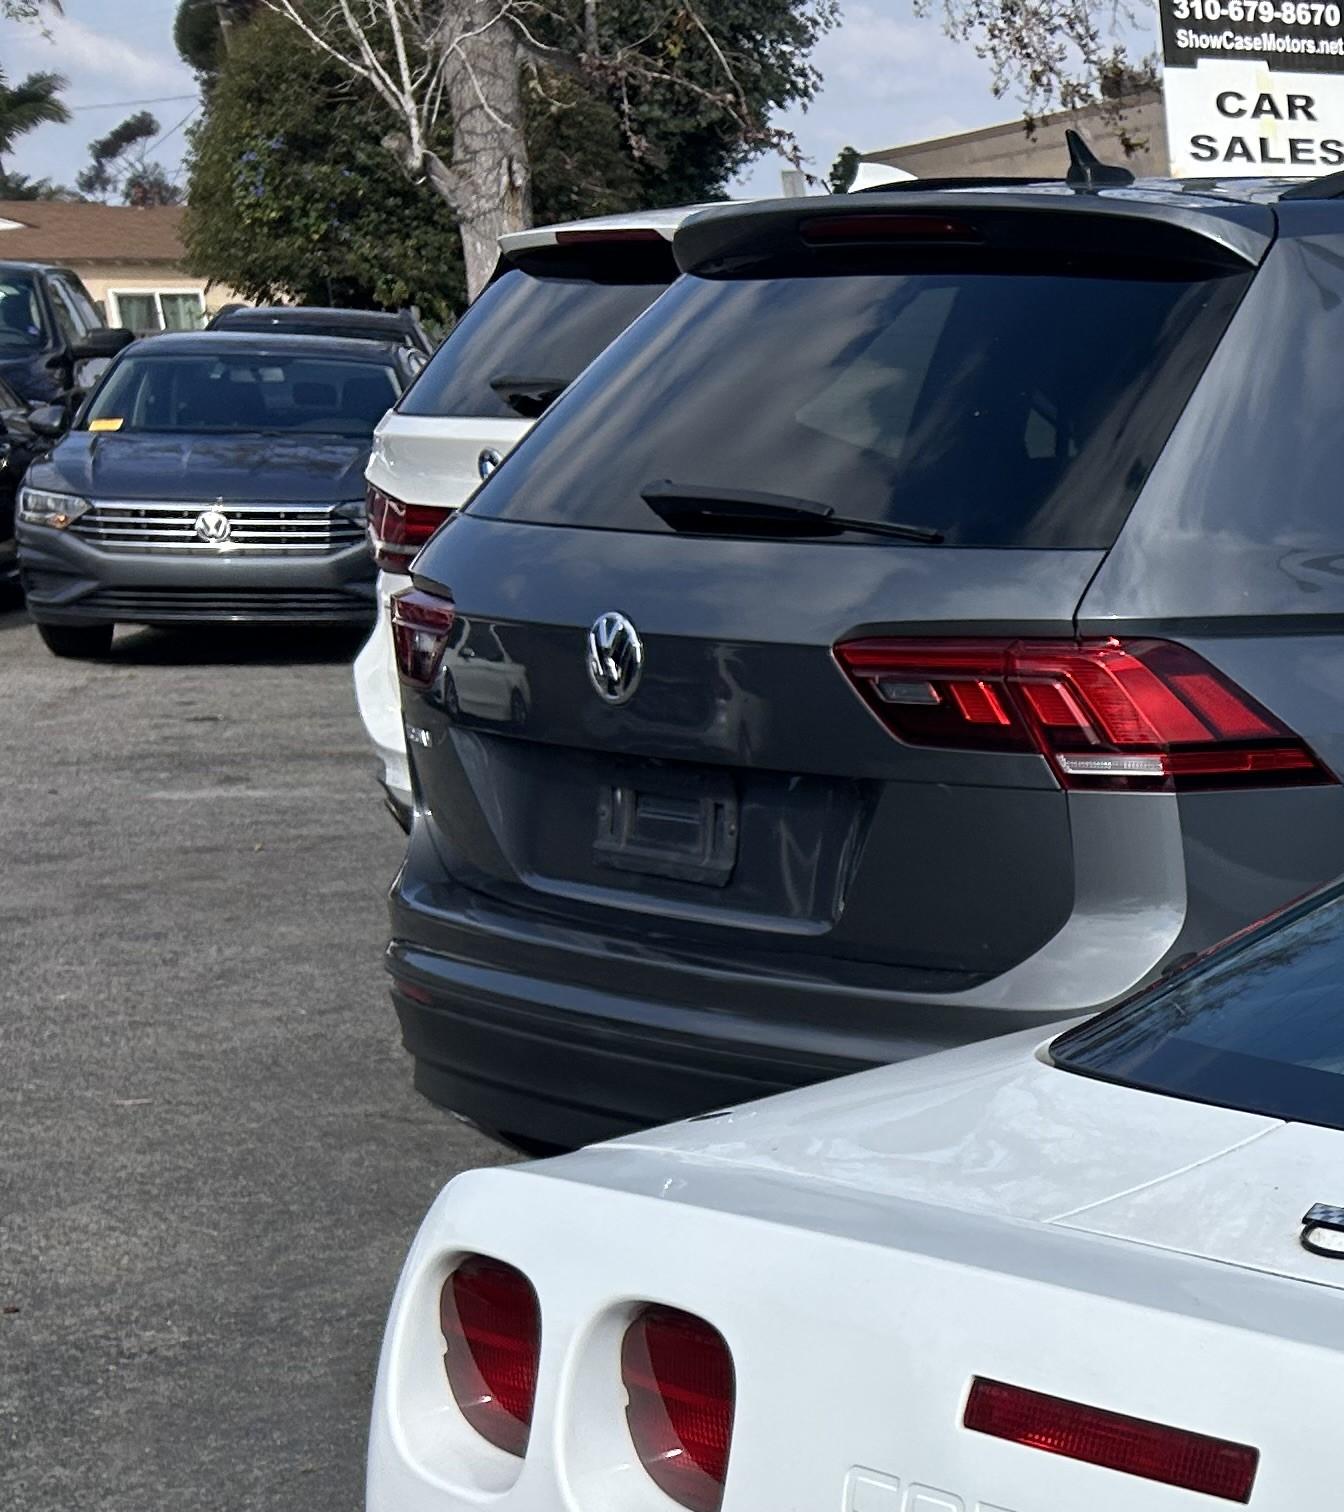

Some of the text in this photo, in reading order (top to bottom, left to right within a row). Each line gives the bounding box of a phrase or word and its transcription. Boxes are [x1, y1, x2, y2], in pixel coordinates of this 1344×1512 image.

[1173, 0, 1341, 26] 310-679-8670
[1176, 29, 1344, 55] ShowCaseMotors.net
[1216, 91, 1317, 121] CAR
